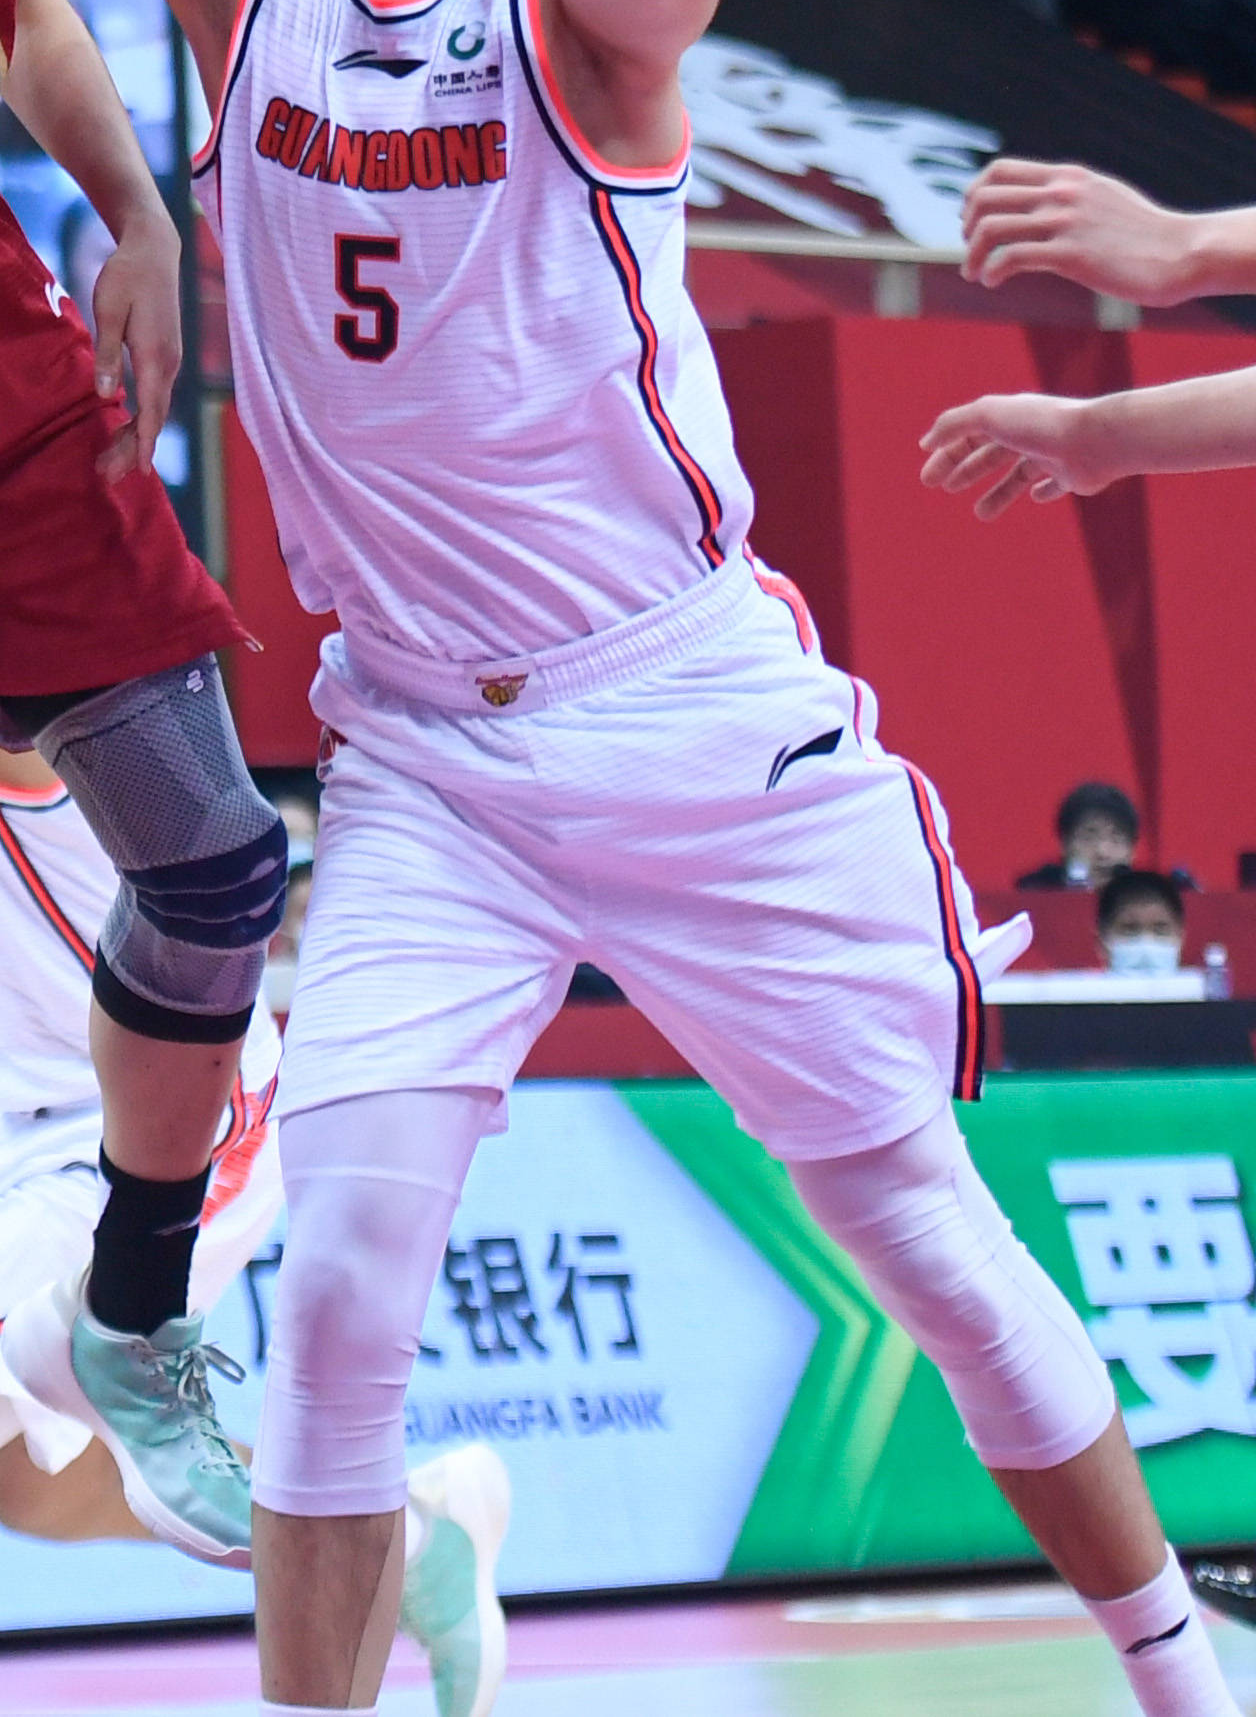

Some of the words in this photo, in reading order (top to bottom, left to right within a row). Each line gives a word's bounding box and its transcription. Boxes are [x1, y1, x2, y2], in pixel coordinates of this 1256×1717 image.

[434, 86, 473, 98] CHINA
[476, 80, 502, 93] LIFE
[256, 96, 507, 192] GUANGDONG
[334, 232, 401, 365] 5
[570, 1390, 670, 1437] BANK
